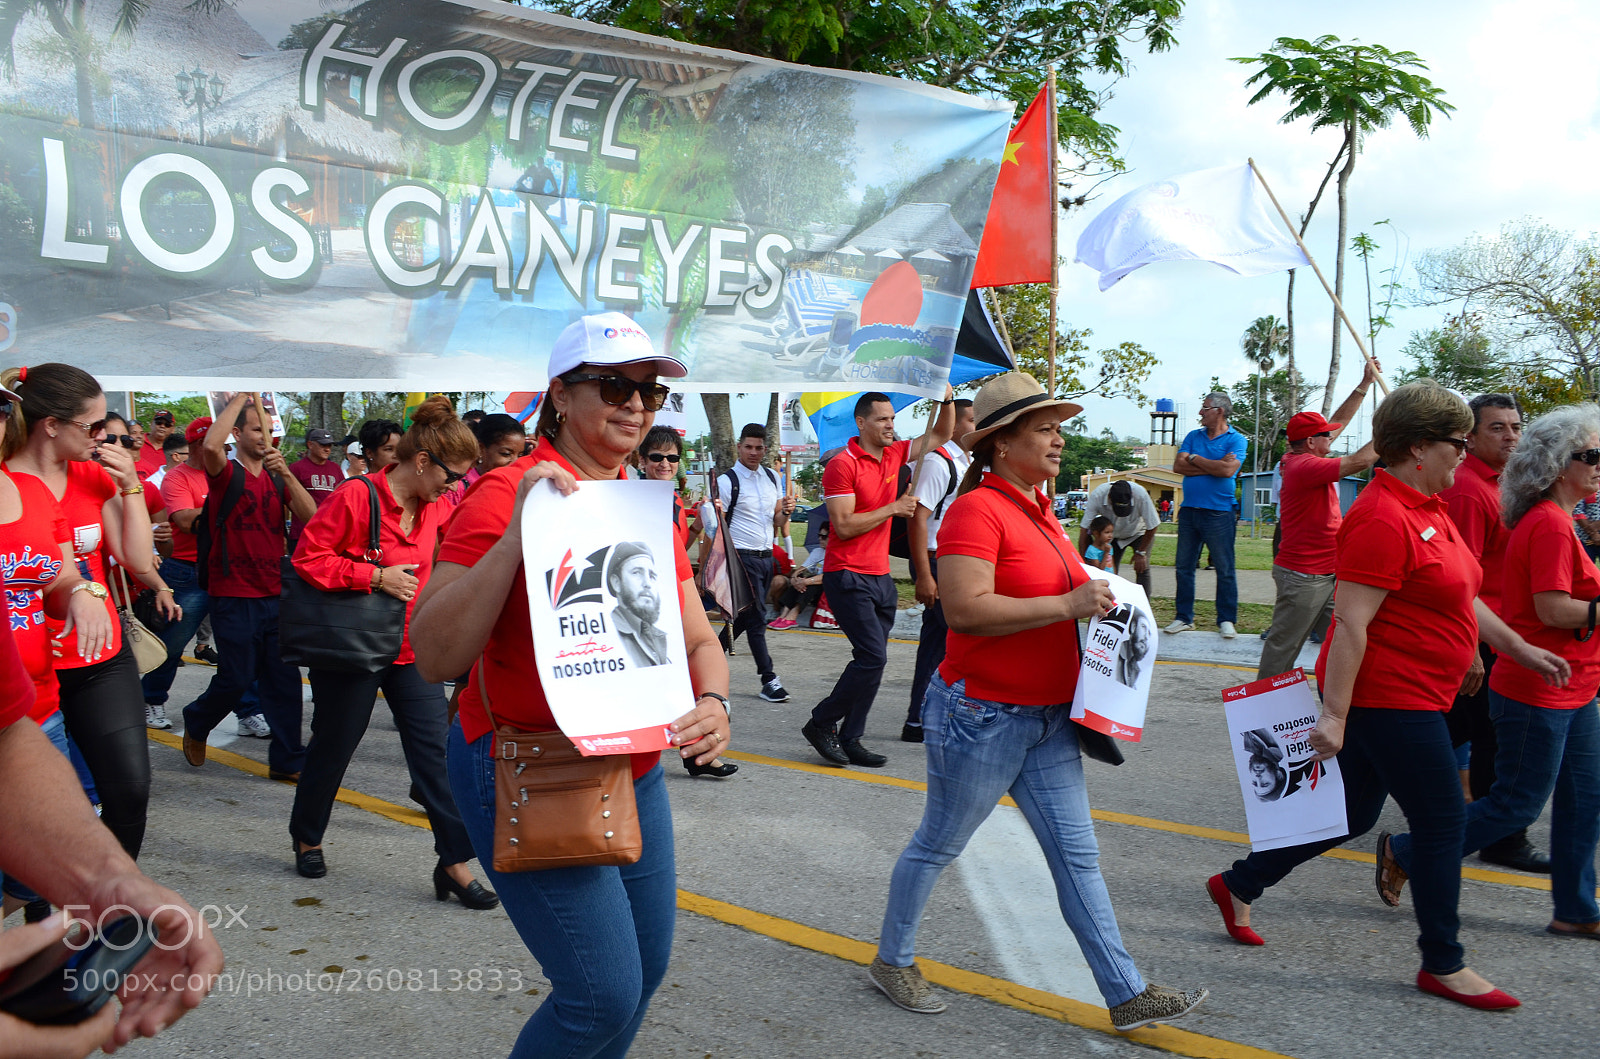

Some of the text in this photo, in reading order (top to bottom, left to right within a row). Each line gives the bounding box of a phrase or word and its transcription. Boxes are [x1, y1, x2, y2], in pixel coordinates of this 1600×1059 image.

[304, 21, 639, 161] HOTEL
[40, 137, 794, 309] LOS CANEYES
[850, 364, 933, 385] HORIZONTES
[310, 474, 336, 489] GAP
[559, 612, 607, 637] Fidel
[555, 636, 614, 659] entre
[1092, 627, 1119, 652] Fidel
[552, 657, 625, 679] nosotros
[1272, 714, 1316, 733] nosotros
[1285, 739, 1315, 758] Fidel
